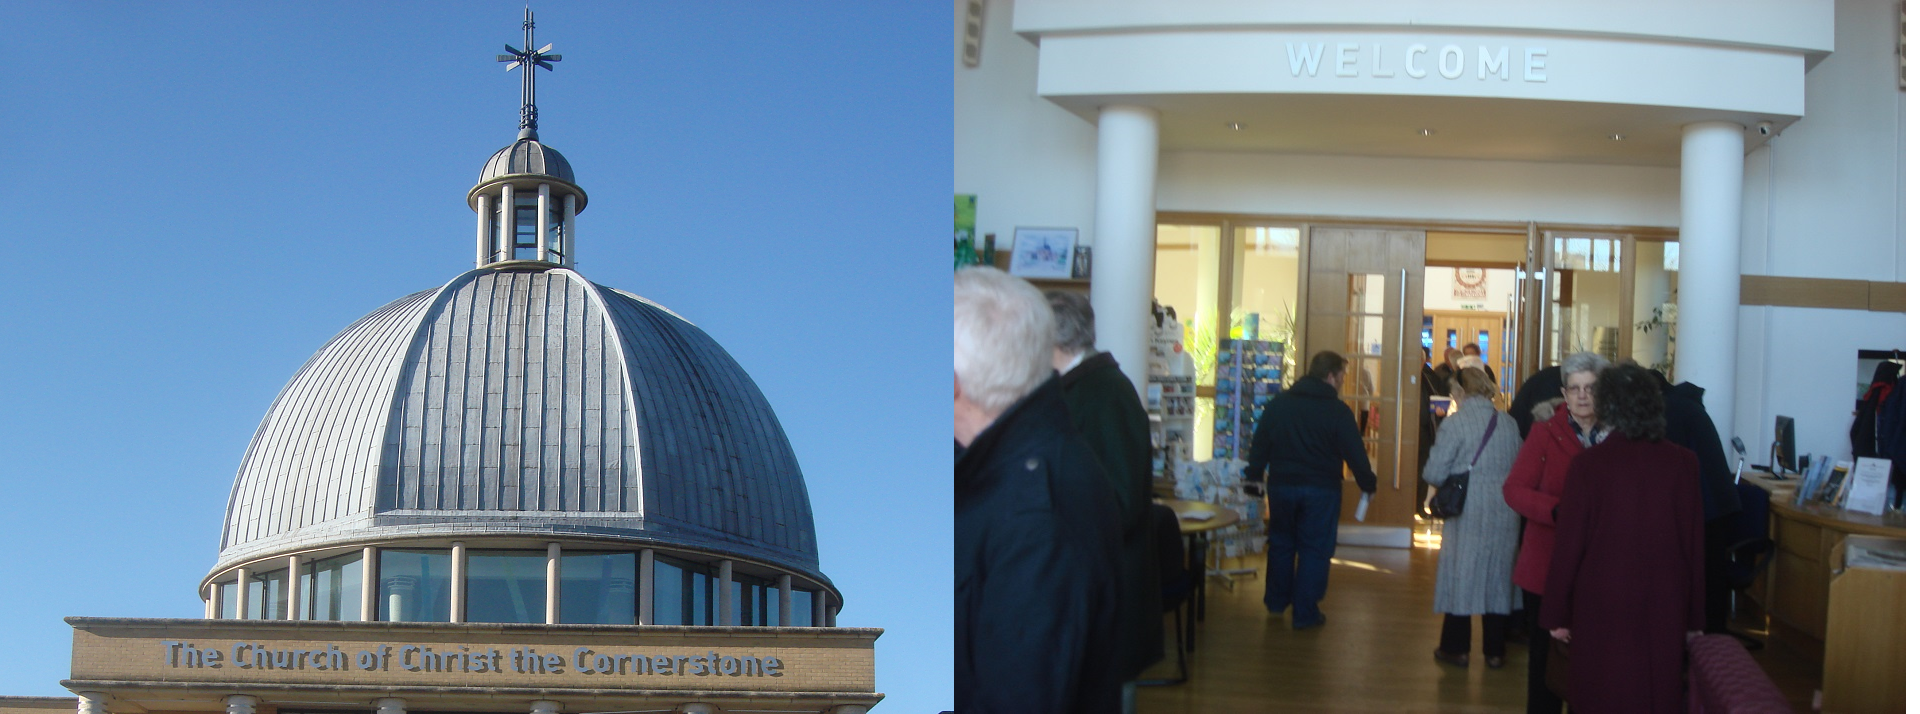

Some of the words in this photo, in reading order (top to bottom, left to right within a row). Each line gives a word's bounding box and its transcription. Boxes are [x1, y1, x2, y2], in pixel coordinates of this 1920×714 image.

[1285, 42, 1549, 82] WELCOME
[161, 640, 218, 667] The
[231, 642, 343, 670] Church
[356, 643, 388, 669] of
[398, 644, 498, 671] Christ
[508, 646, 561, 672] the
[573, 646, 780, 675] Cornerstone
